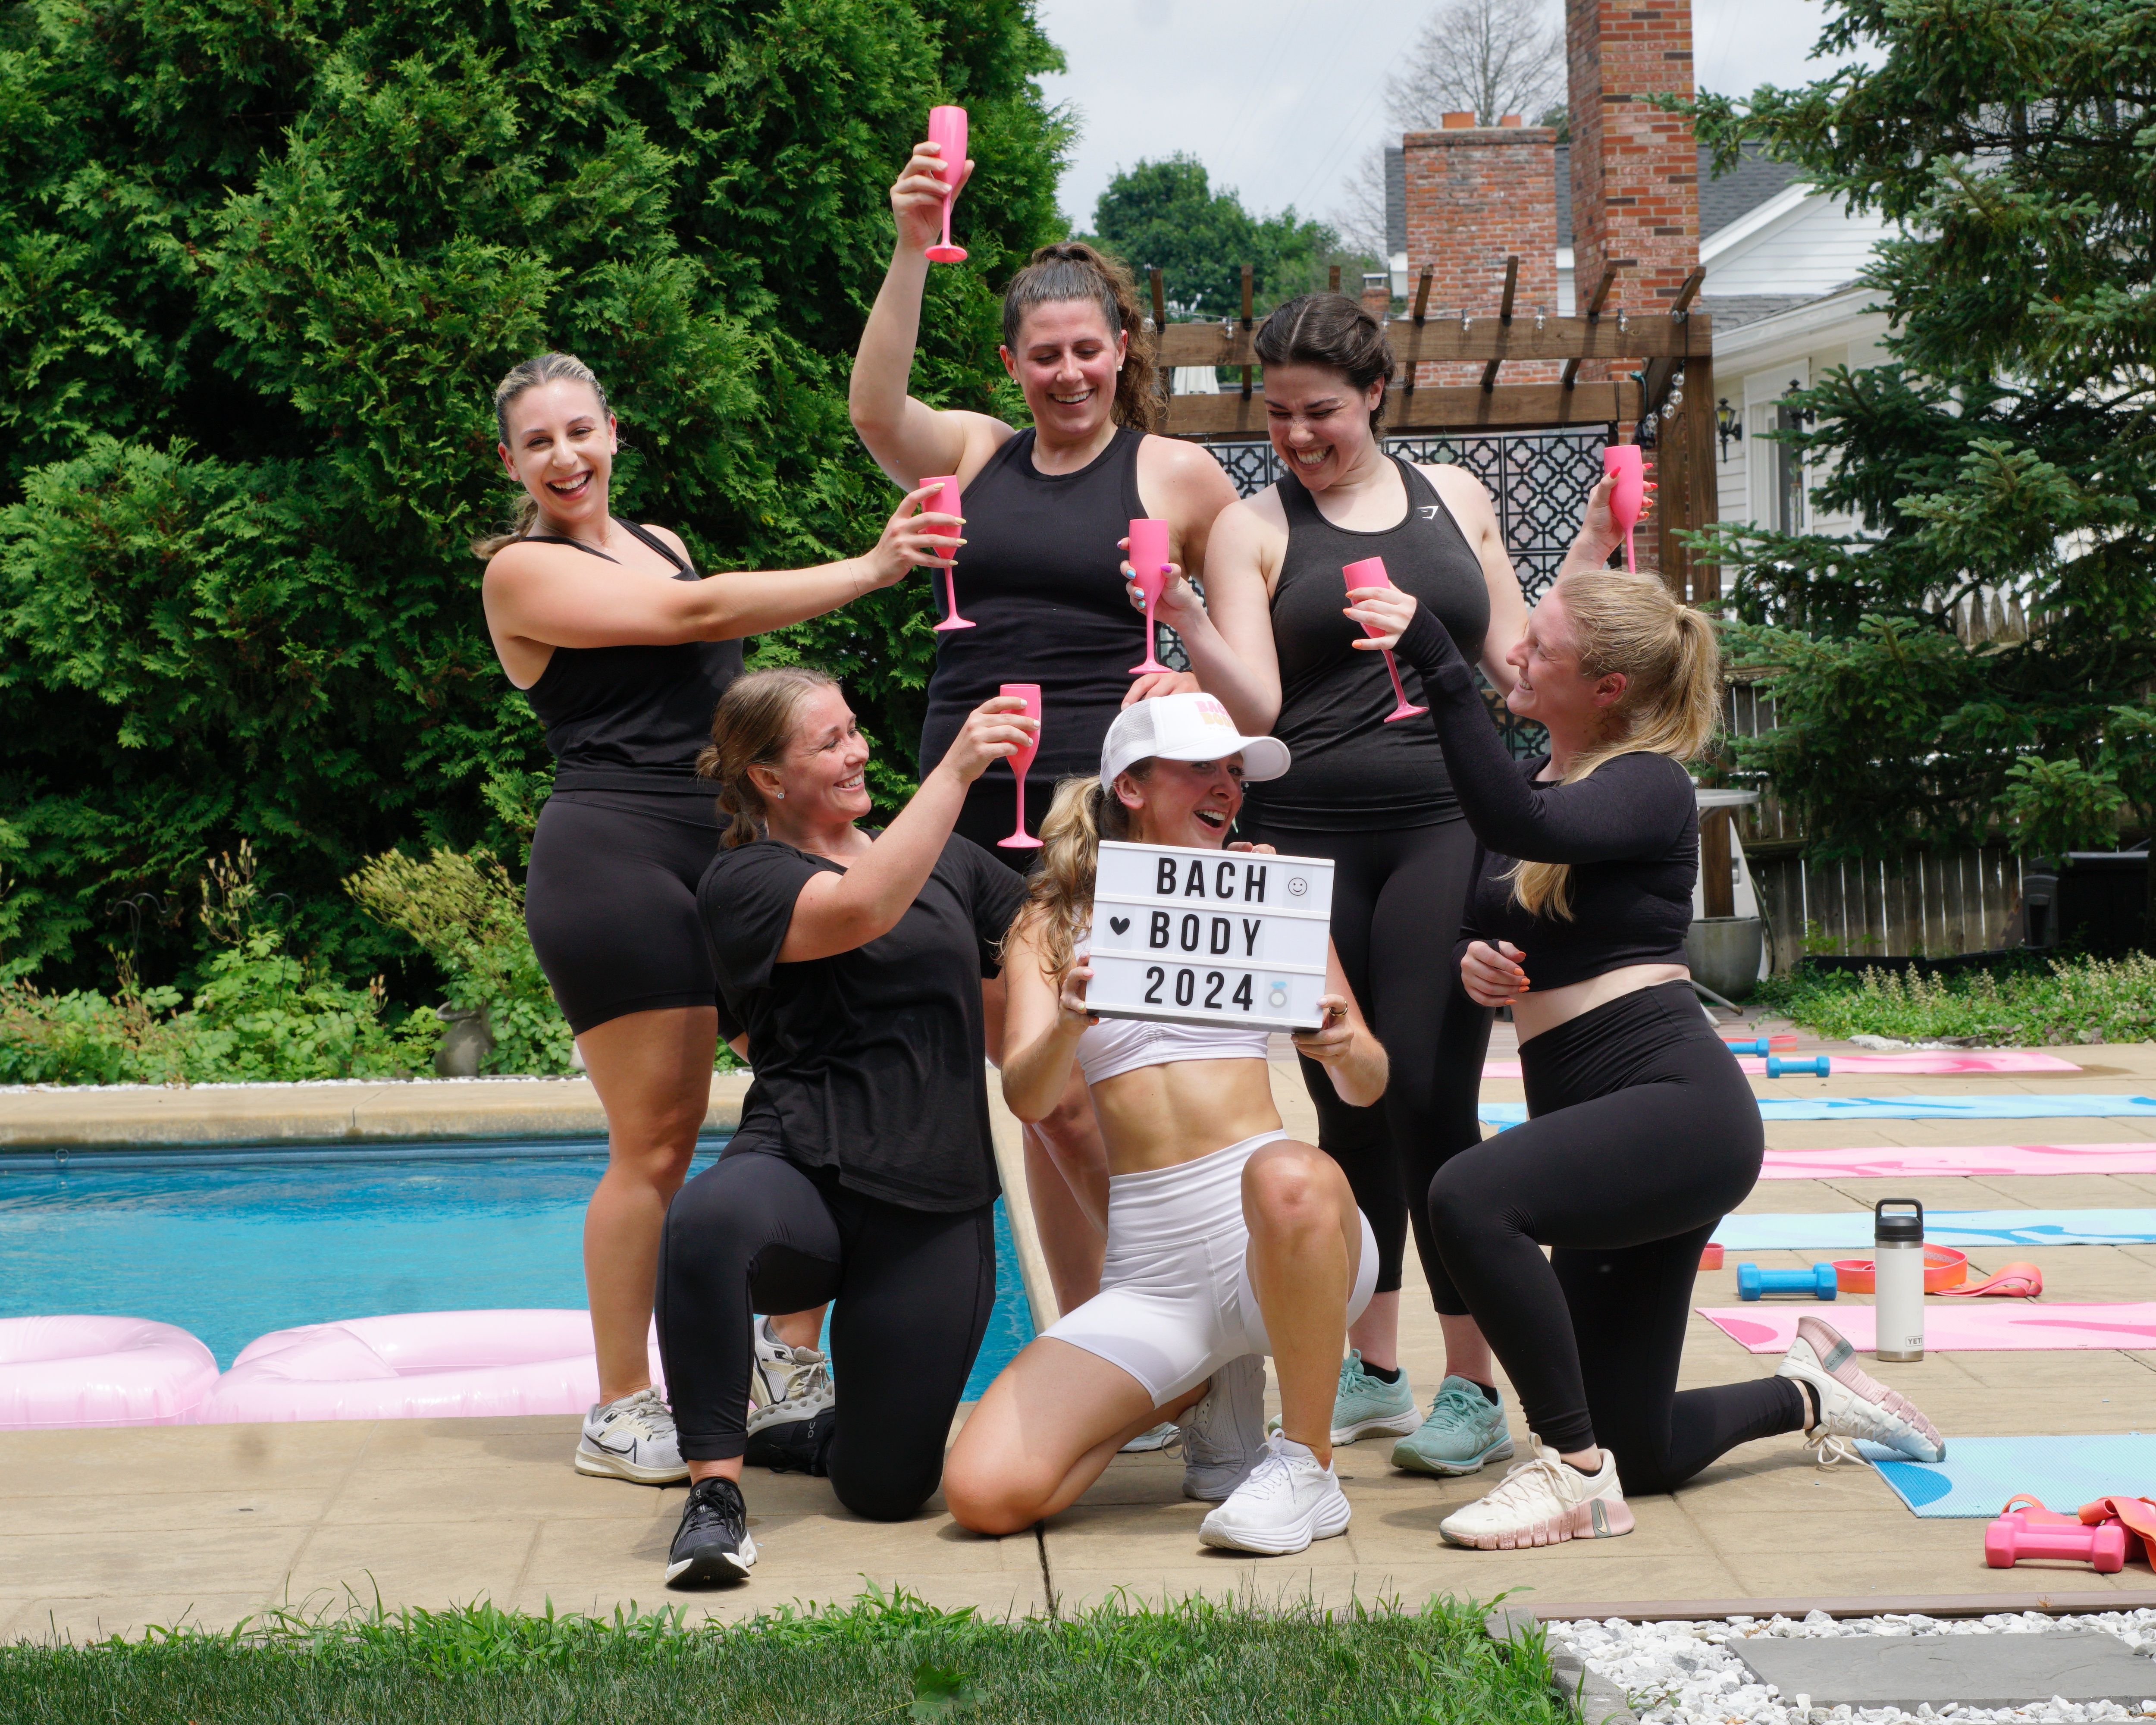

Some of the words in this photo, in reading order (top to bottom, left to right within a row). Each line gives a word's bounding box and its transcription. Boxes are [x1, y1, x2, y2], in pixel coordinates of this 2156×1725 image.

[1156, 857, 1266, 902] BACH
[1150, 911, 1261, 956] BODY
[1144, 966, 1253, 1010] 2024
